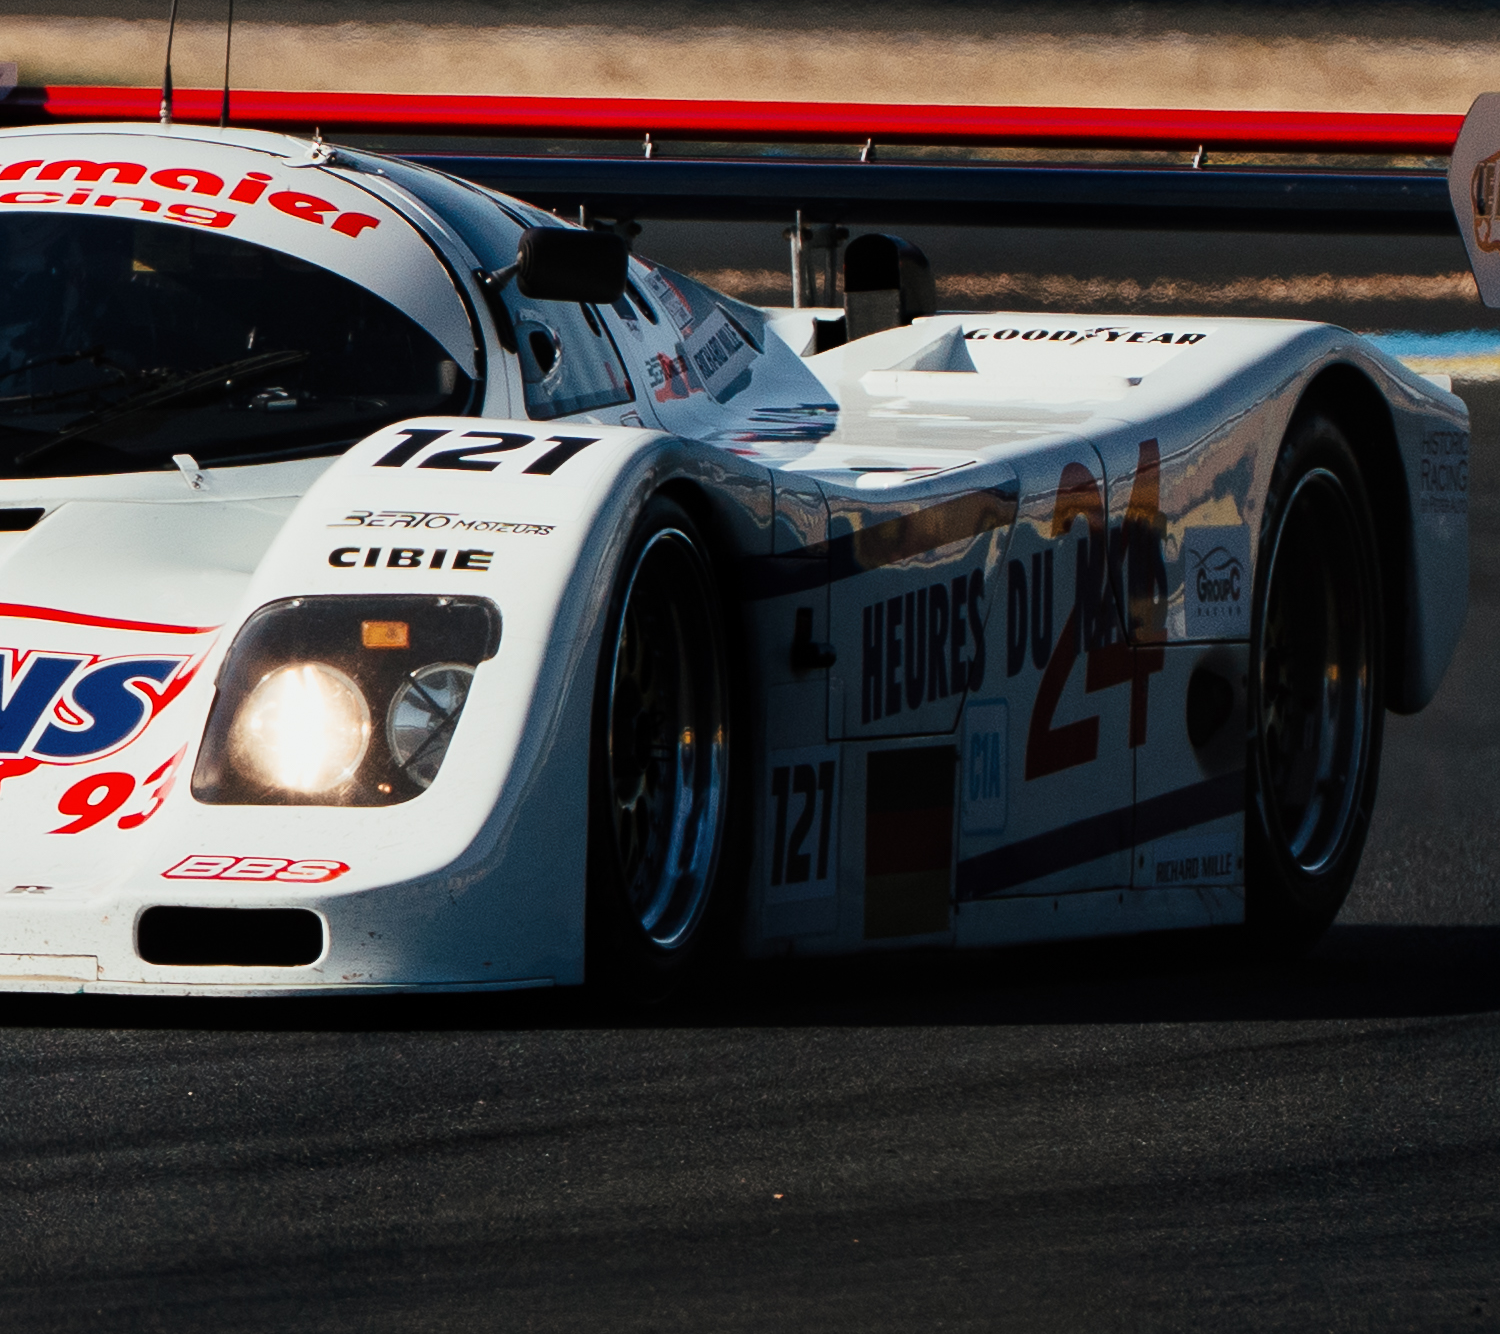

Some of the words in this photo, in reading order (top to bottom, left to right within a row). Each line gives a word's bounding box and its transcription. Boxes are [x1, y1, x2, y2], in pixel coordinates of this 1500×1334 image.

[1475, 163, 1497, 217] LE
[694, 336, 728, 380] RICHARD
[716, 322, 744, 357] MILLE
[372, 428, 603, 475] 121
[326, 510, 460, 529] BERTO
[862, 568, 986, 725] HEURES
[1007, 549, 1053, 677] DU
[1025, 438, 1168, 781] 24
[43, 743, 188, 835] 93
[772, 761, 835, 886] 121
[160, 855, 351, 883] BBS
[1156, 857, 1200, 883] RICHARD
[1202, 852, 1233, 877] MILLE
